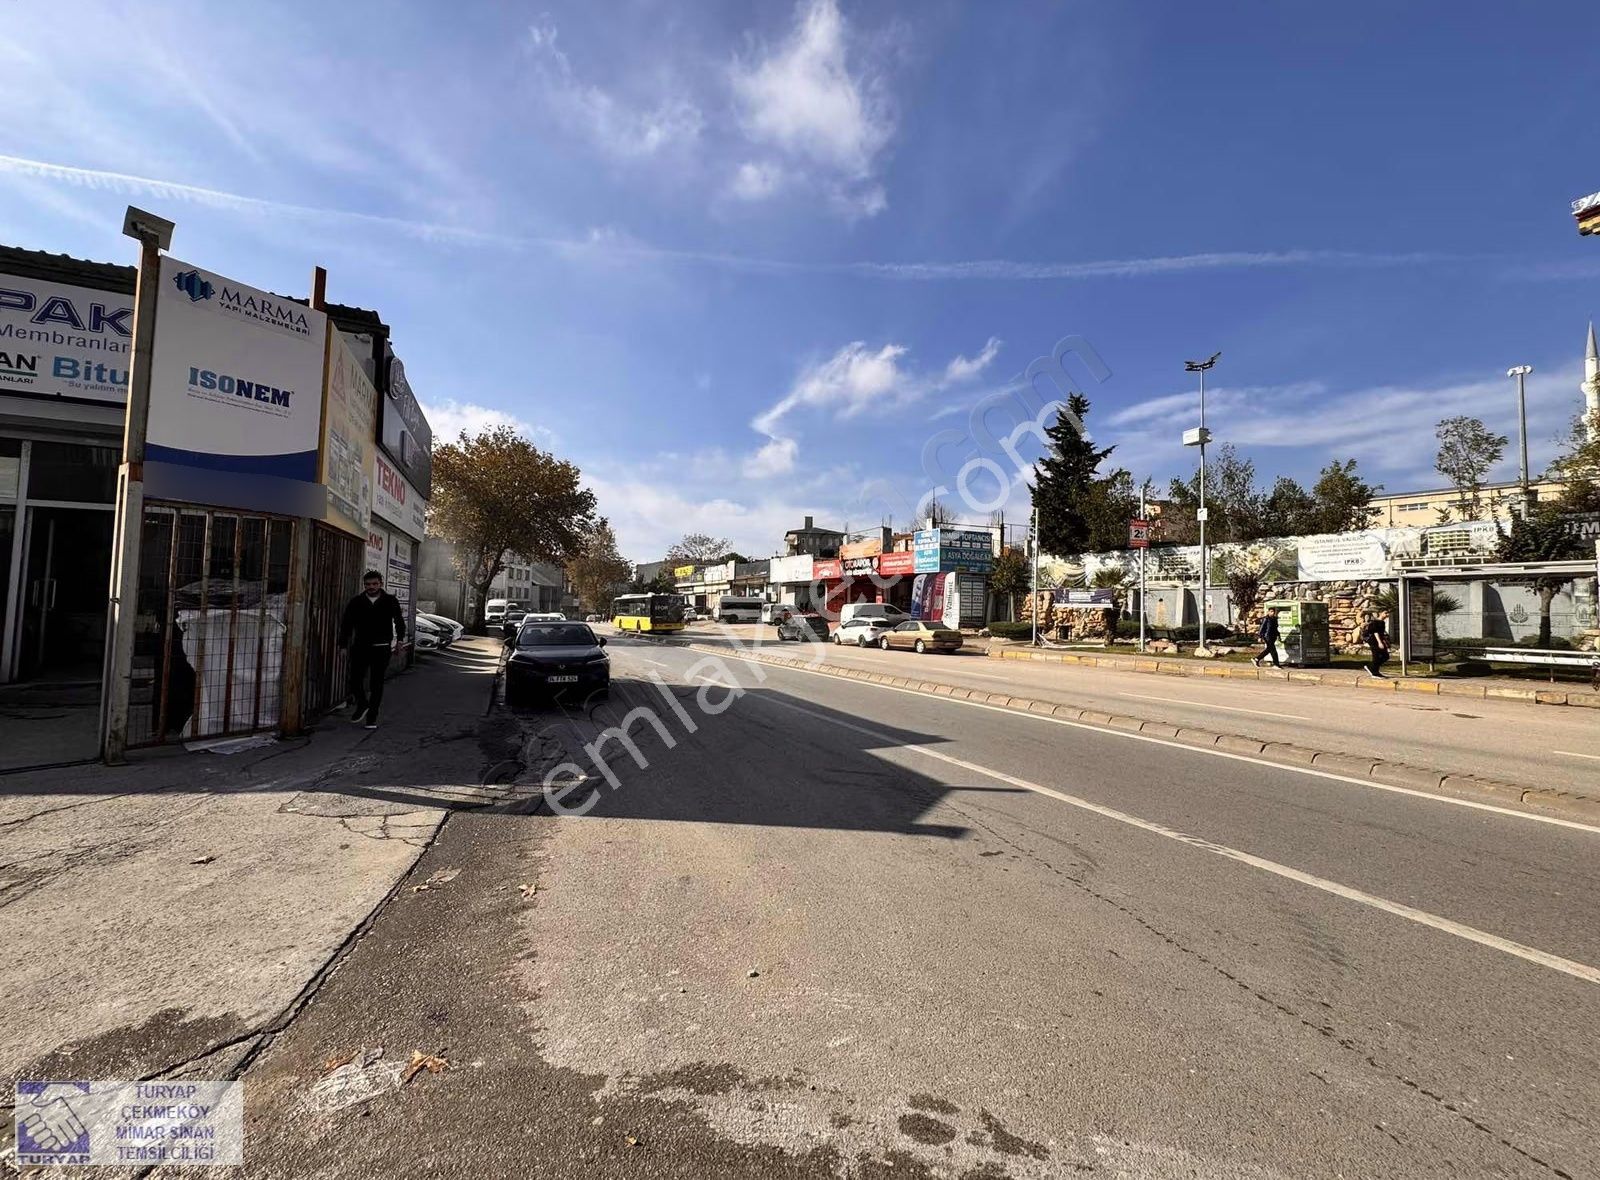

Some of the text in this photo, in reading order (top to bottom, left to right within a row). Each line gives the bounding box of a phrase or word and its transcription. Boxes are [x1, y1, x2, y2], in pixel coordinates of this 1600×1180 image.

[219, 302, 310, 336] YAPI MALZEMELERİ
[220, 287, 308, 328] MARMA
[53, 356, 129, 386] Bitu
[188, 366, 290, 408] ISONEM
[377, 456, 406, 506] TEKNO
